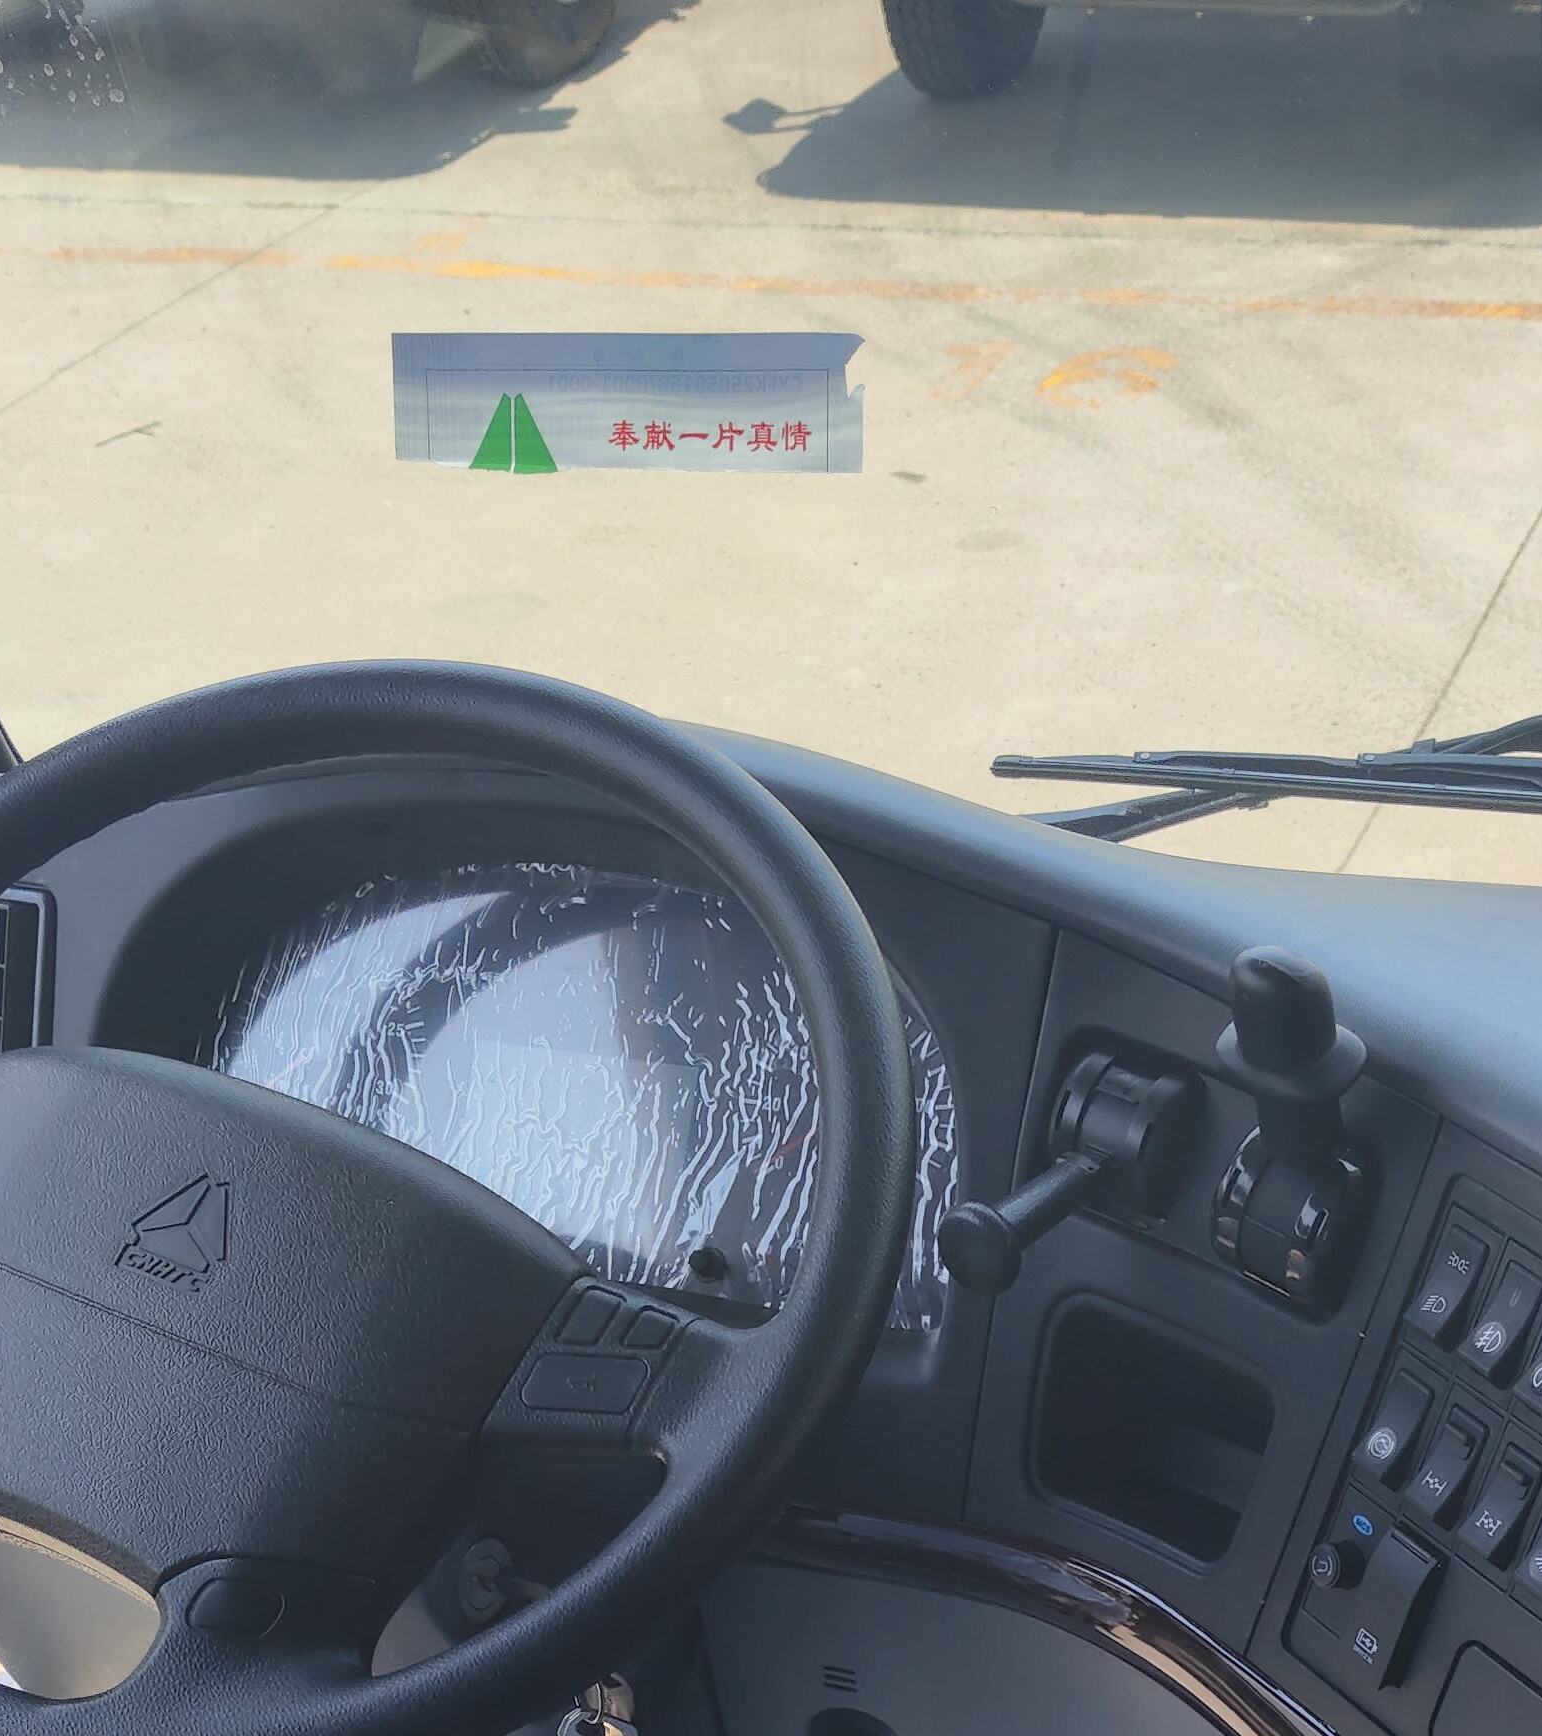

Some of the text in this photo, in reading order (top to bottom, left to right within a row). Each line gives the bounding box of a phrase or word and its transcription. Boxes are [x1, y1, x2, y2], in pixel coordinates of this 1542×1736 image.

[608, 419, 813, 452] 奉献一片真情
[387, 1022, 404, 1037] 25
